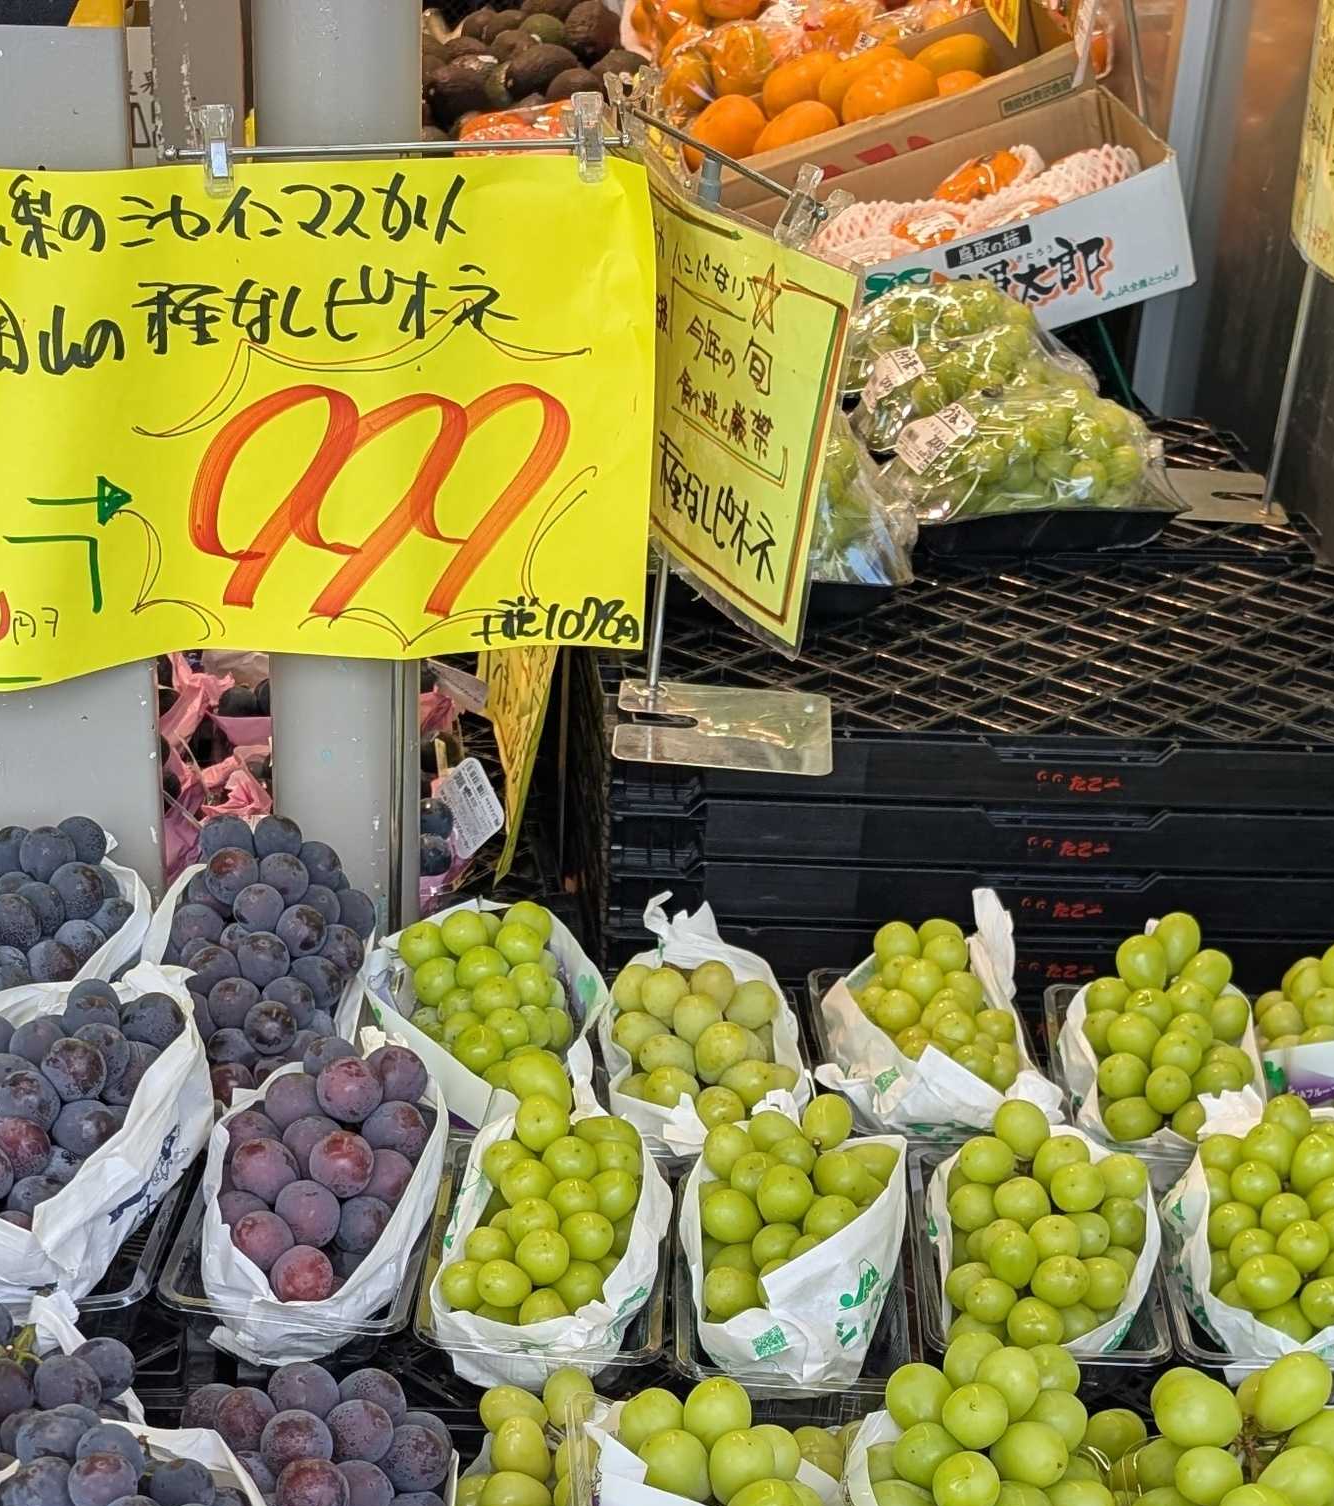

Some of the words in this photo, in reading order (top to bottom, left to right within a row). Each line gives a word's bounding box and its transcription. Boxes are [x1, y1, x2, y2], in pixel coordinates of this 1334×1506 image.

[959, 232, 1020, 265] 鳥取の柿
[189, 384, 570, 619] 999
